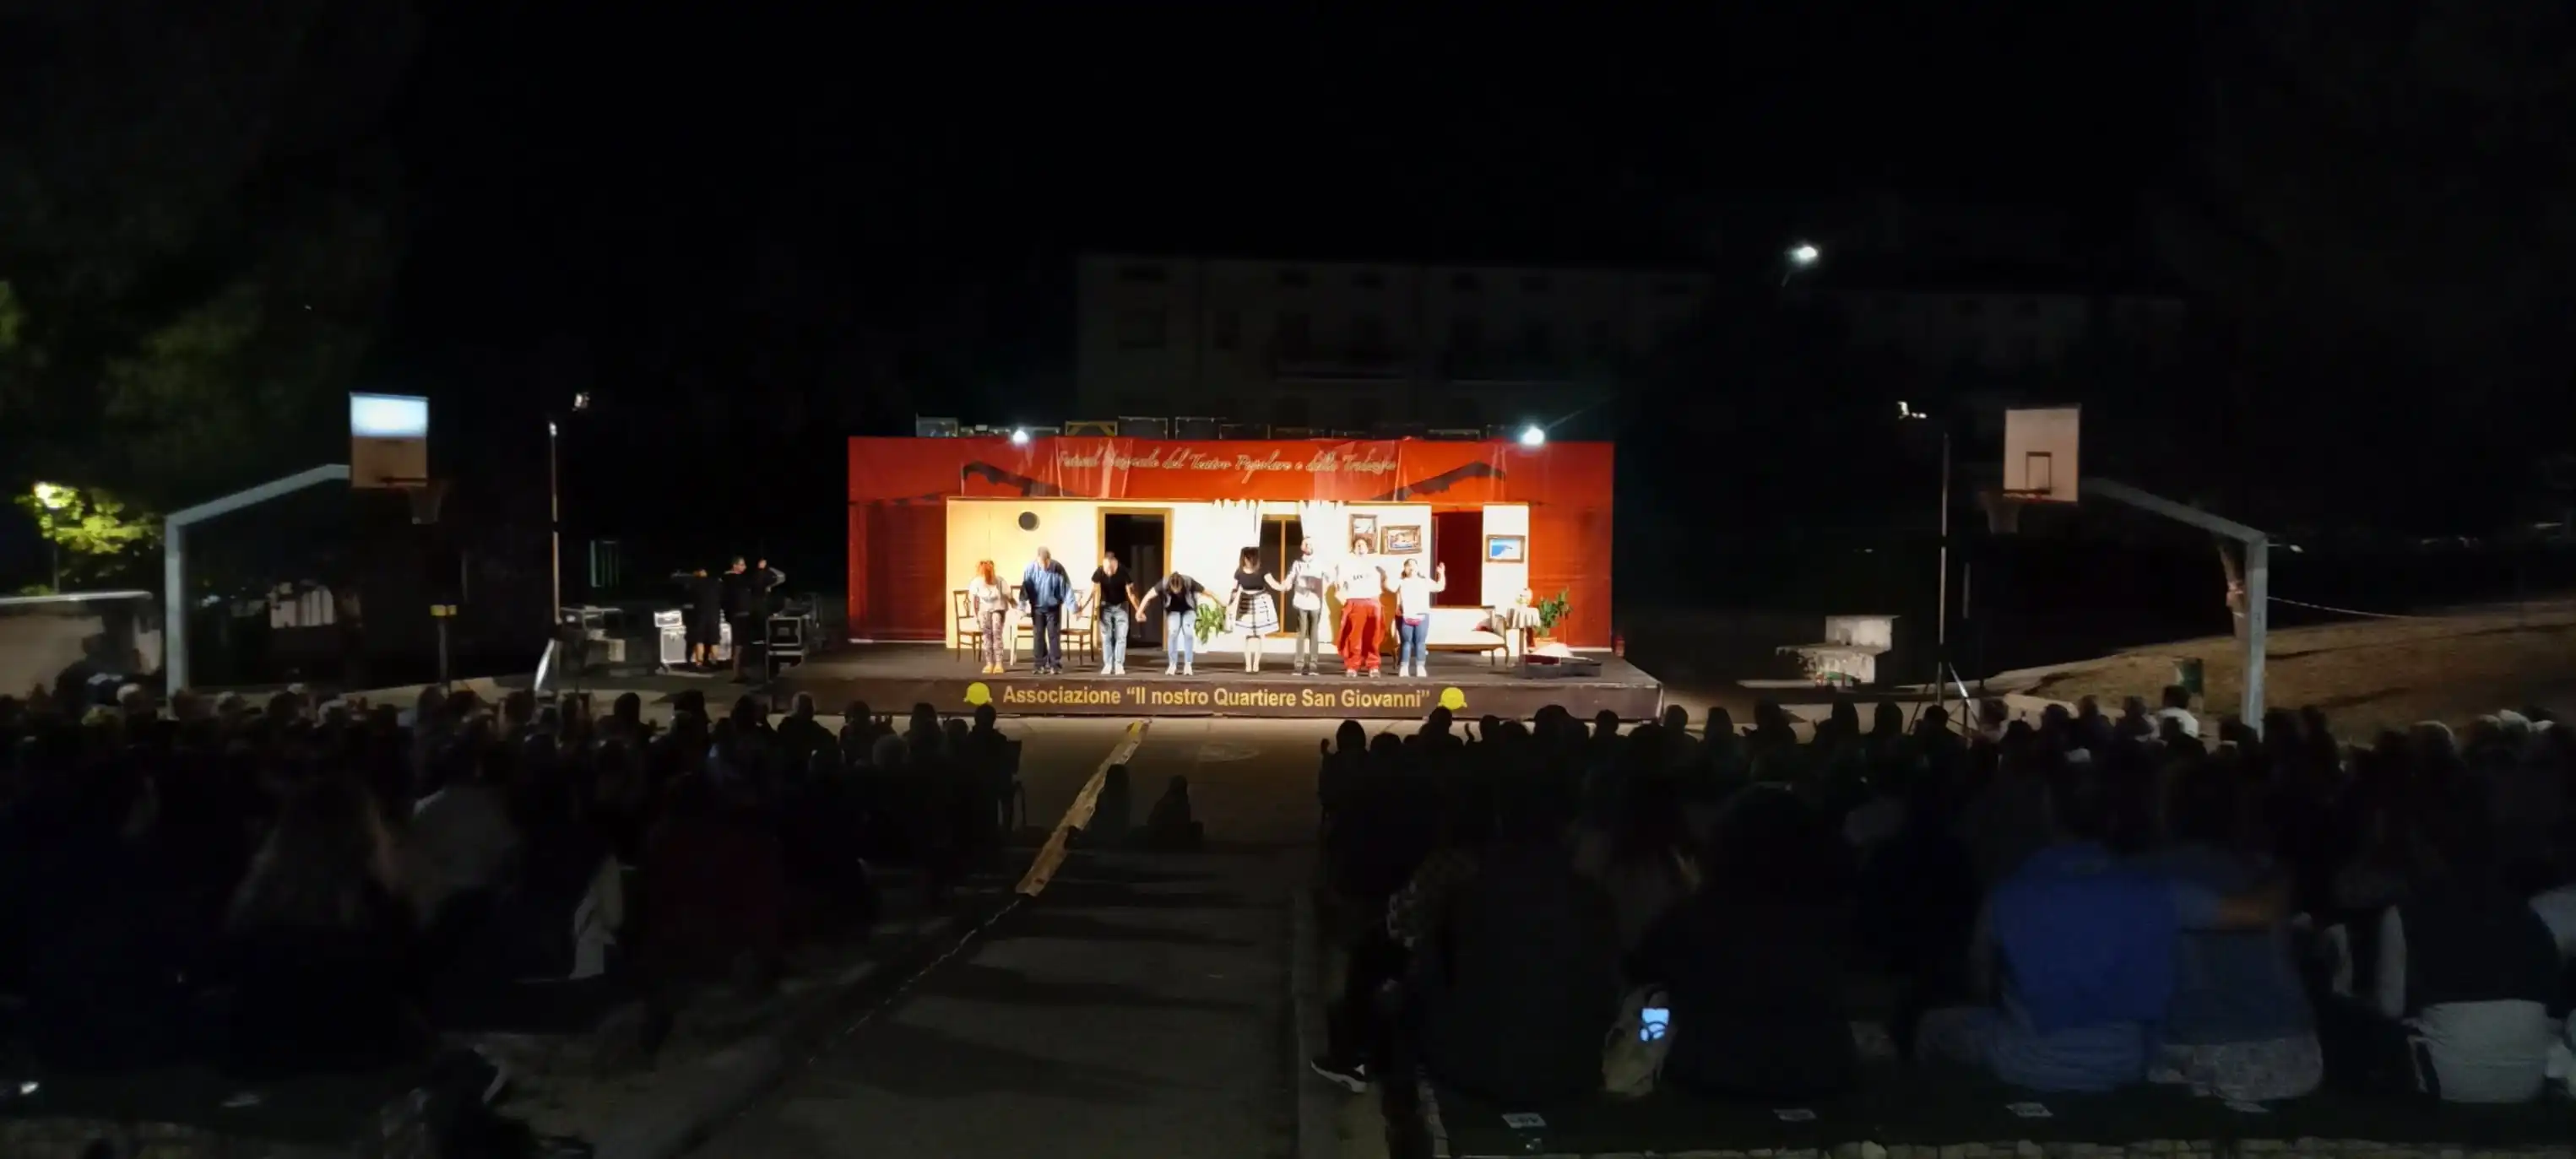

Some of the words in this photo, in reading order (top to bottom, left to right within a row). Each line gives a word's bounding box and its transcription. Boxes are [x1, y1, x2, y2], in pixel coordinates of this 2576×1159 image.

[1003, 685, 1121, 704] Associazione
[1151, 688, 1209, 705] nostro
[1214, 687, 1297, 707] Quartiere
[1301, 688, 1336, 707] San
